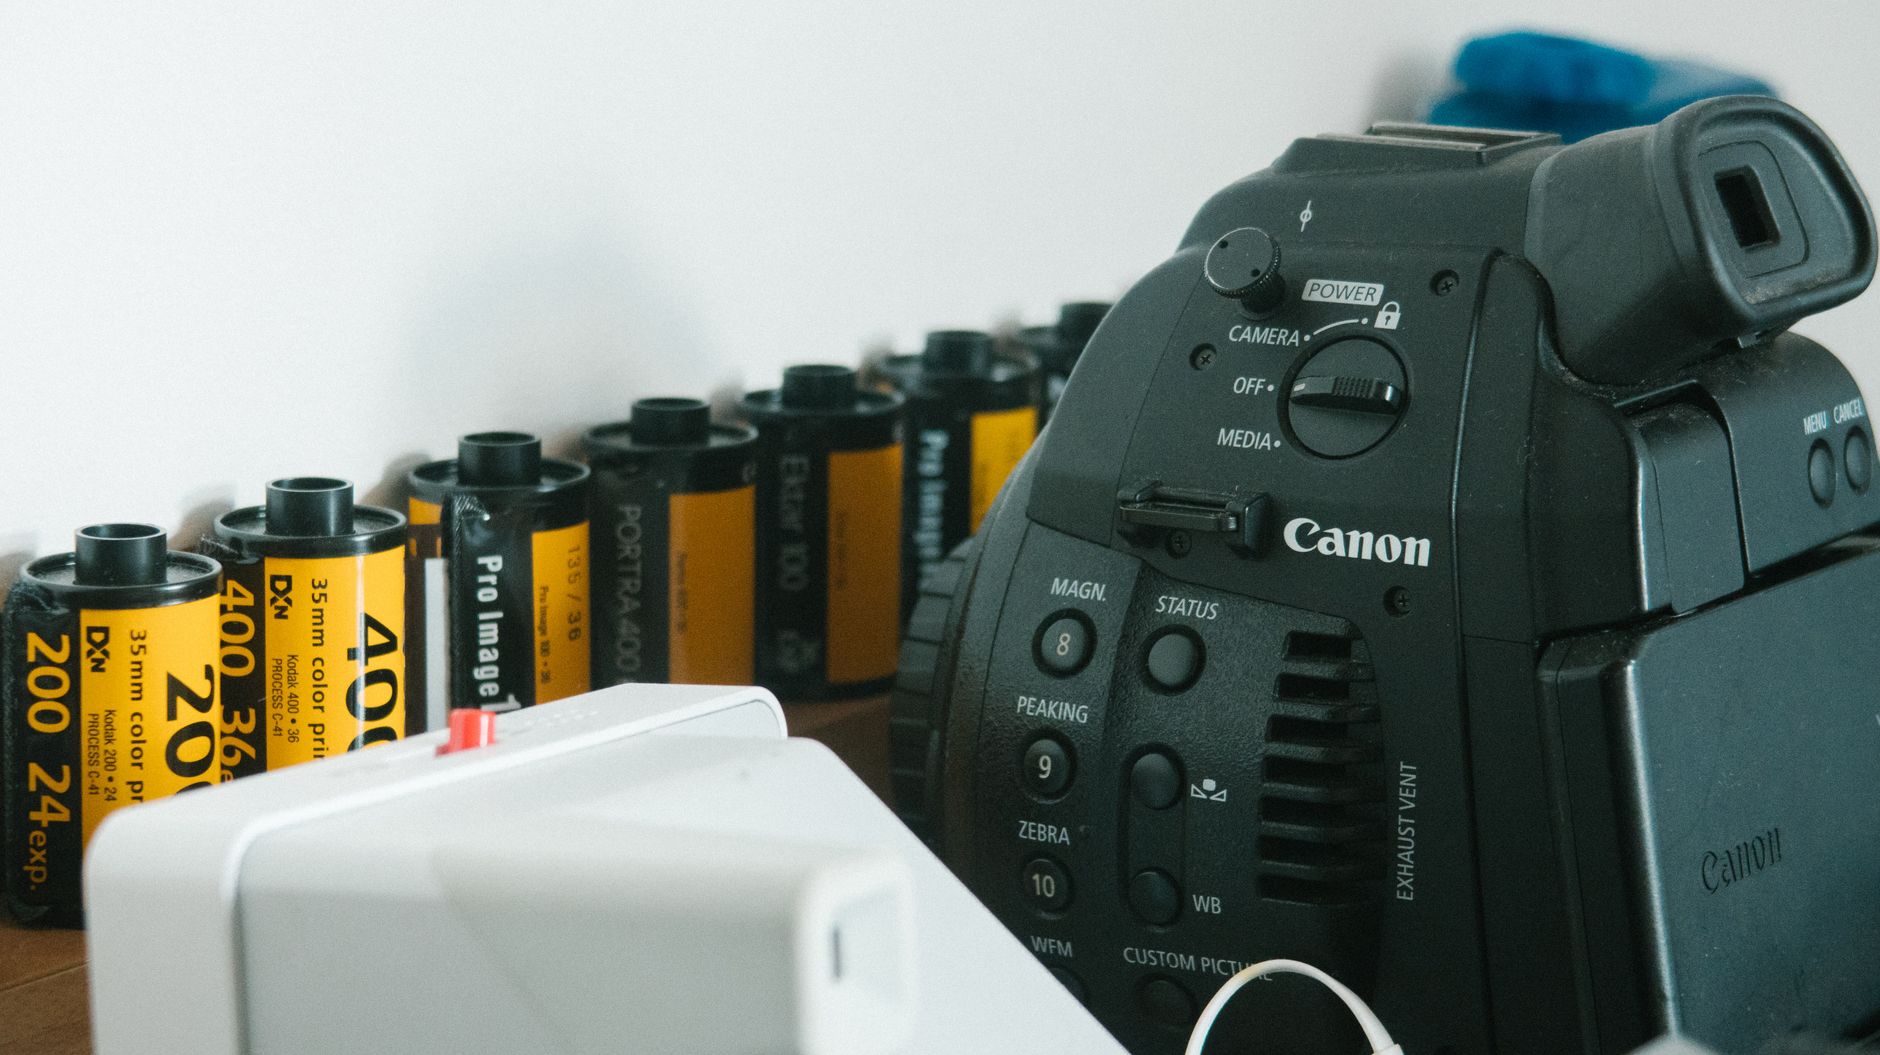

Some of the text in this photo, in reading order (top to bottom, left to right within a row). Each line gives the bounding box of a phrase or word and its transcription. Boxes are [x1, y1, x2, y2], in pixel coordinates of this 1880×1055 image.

[1308, 282, 1378, 302] POWER
[1229, 325, 1300, 347] CAMERA
[1233, 377, 1266, 396] OFF
[1803, 410, 1828, 435] MENU
[1833, 397, 1865, 424] CANCEL
[1217, 428, 1272, 450] MEDIA
[1283, 517, 1431, 567] Canon
[477, 554, 503, 602] Pro
[567, 545, 581, 584] 135
[616, 504, 642, 672] PORTRA 400
[1051, 577, 1106, 601] MAGN.
[1155, 595, 1219, 620] STATUS
[220, 579, 255, 677] 400
[312, 579, 328, 647] 35mm
[567, 611, 581, 641] 36
[473, 611, 504, 697] Image
[1056, 633, 1070, 656] 8
[27, 631, 71, 733] 200
[130, 629, 147, 701] 35mm
[271, 658, 283, 737] PROCESS C-41
[287, 654, 300, 743] Kodak 400 36
[312, 657, 328, 713] color
[165, 664, 215, 795] 20
[1016, 696, 1088, 724] PEAKING
[88, 713, 100, 796] PROCESS C-41
[104, 709, 118, 801] Kodak 200 24
[130, 711, 147, 770] color
[1038, 755, 1051, 779] 9
[1018, 820, 1071, 846] ZEBRA
[1396, 761, 1417, 901] EXHAUST VENT
[1702, 827, 1782, 895] Canon
[1032, 874, 1055, 898] 10
[1192, 894, 1222, 914] WB
[1031, 935, 1073, 958] WFM
[1123, 947, 1273, 982] CUSTOM PICT
